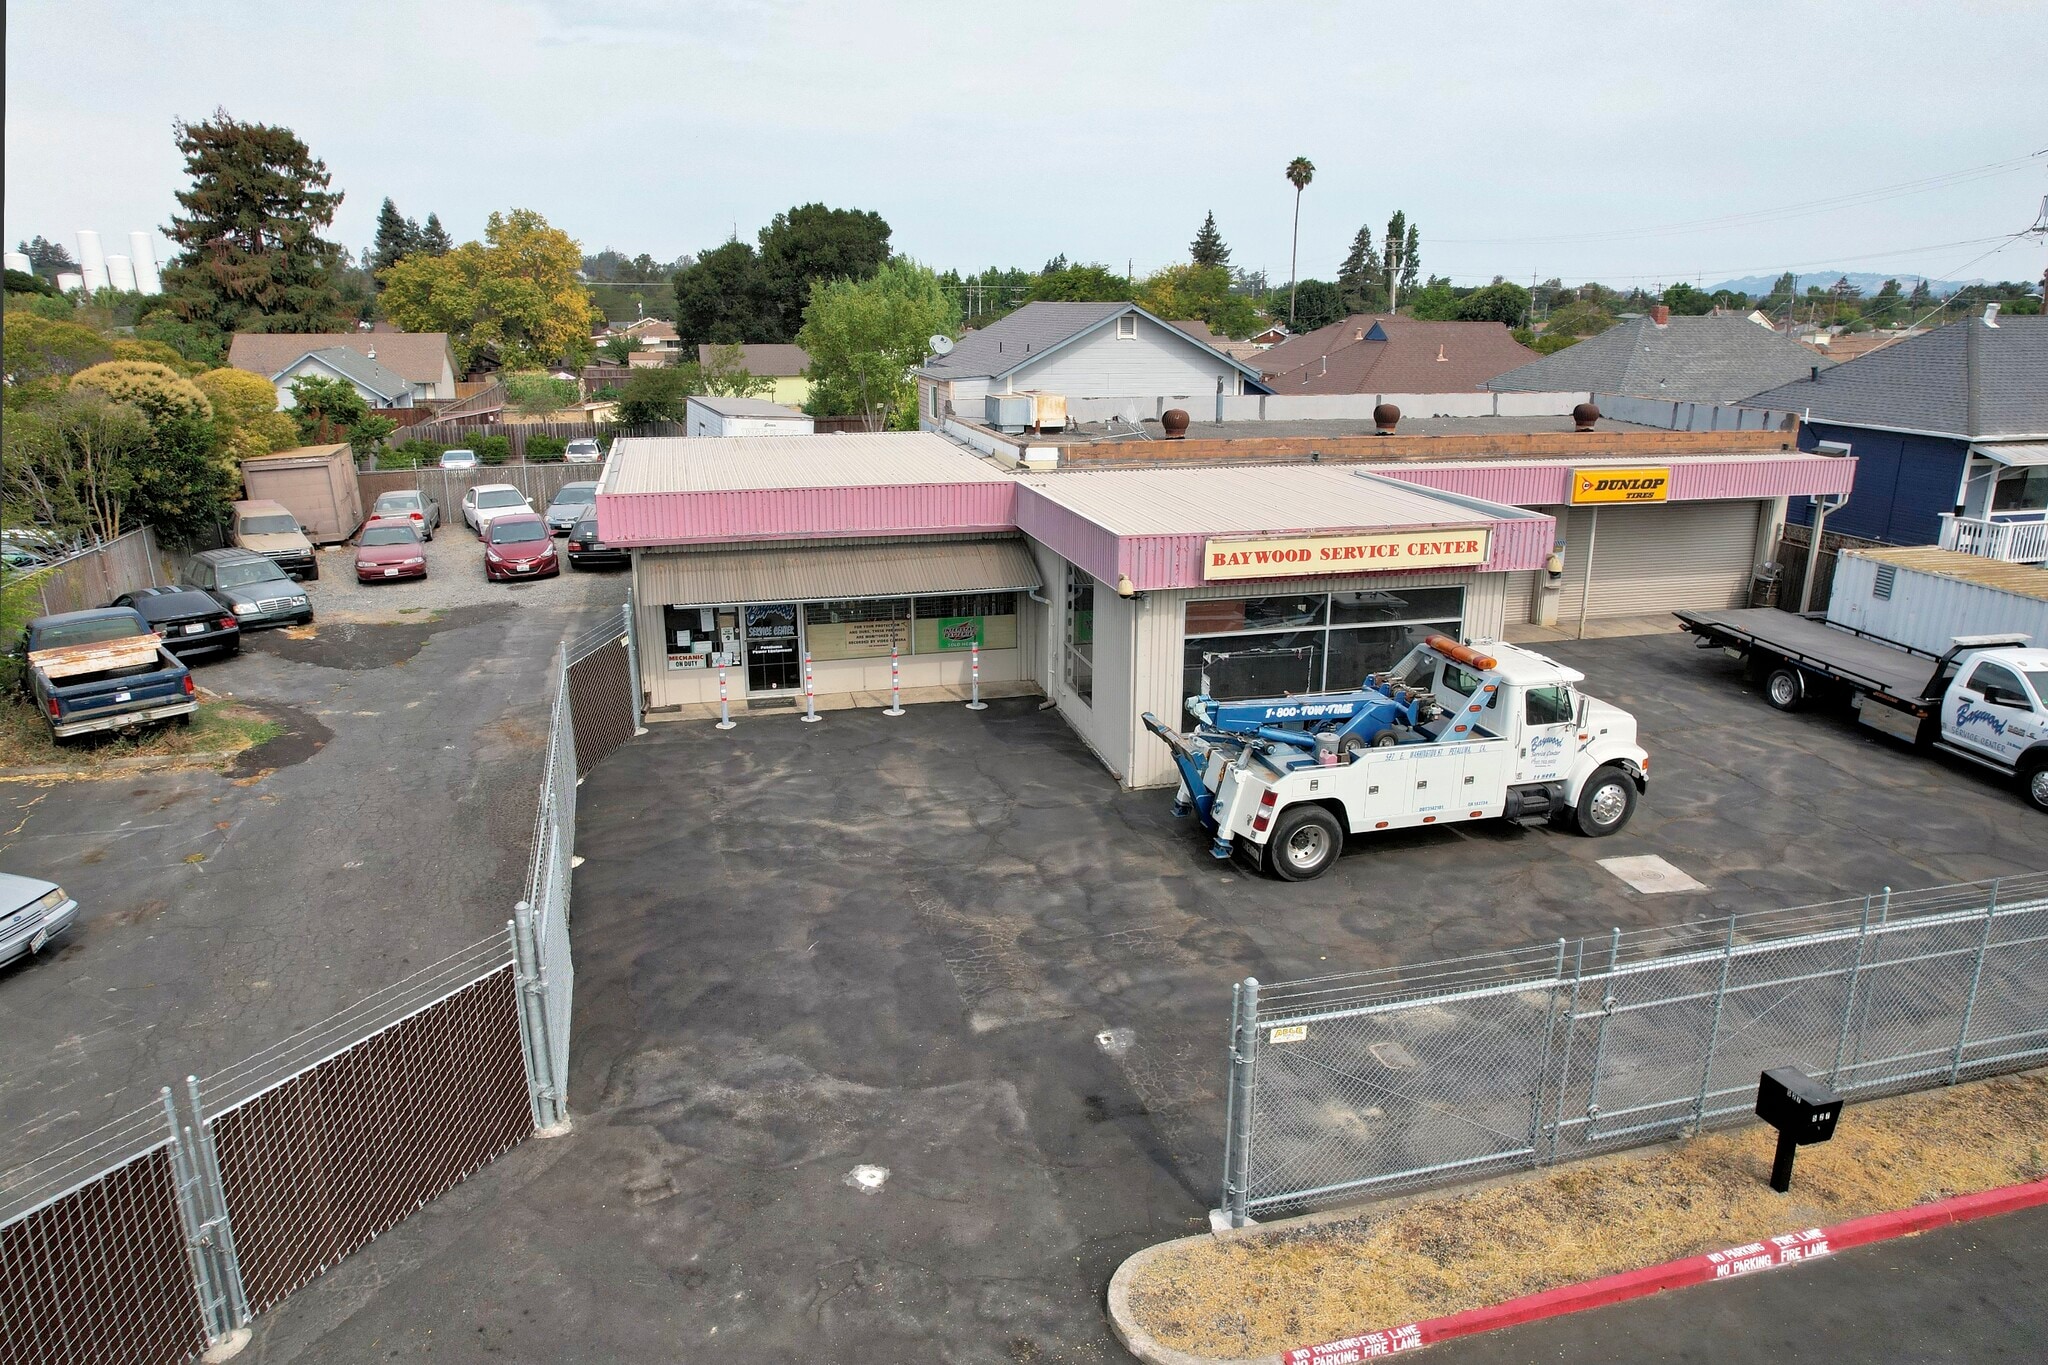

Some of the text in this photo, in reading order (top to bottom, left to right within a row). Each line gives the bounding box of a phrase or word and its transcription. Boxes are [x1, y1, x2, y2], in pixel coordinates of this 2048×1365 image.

[1595, 479, 1665, 491] DUNLOP
[1212, 540, 1479, 567] BAYWOOD SERVICE CENTER
[749, 626, 772, 636] SERVICE
[1956, 703, 2008, 737] Baywood
[1531, 735, 1564, 752] Baywood
[1952, 726, 1979, 743] SERVICE
[1981, 738, 2007, 753] CENTER
[1707, 1228, 1826, 1264] NO PARKING FIRE LANE
[1717, 1241, 1831, 1277] NO PARKING FIRE LANE
[1292, 1324, 1421, 1361] NO PARKING FIRE LANE
[1313, 1349, 1360, 1365] PARKING
[1364, 1341, 1389, 1358] FIRE
[1393, 1335, 1423, 1352] LANE
